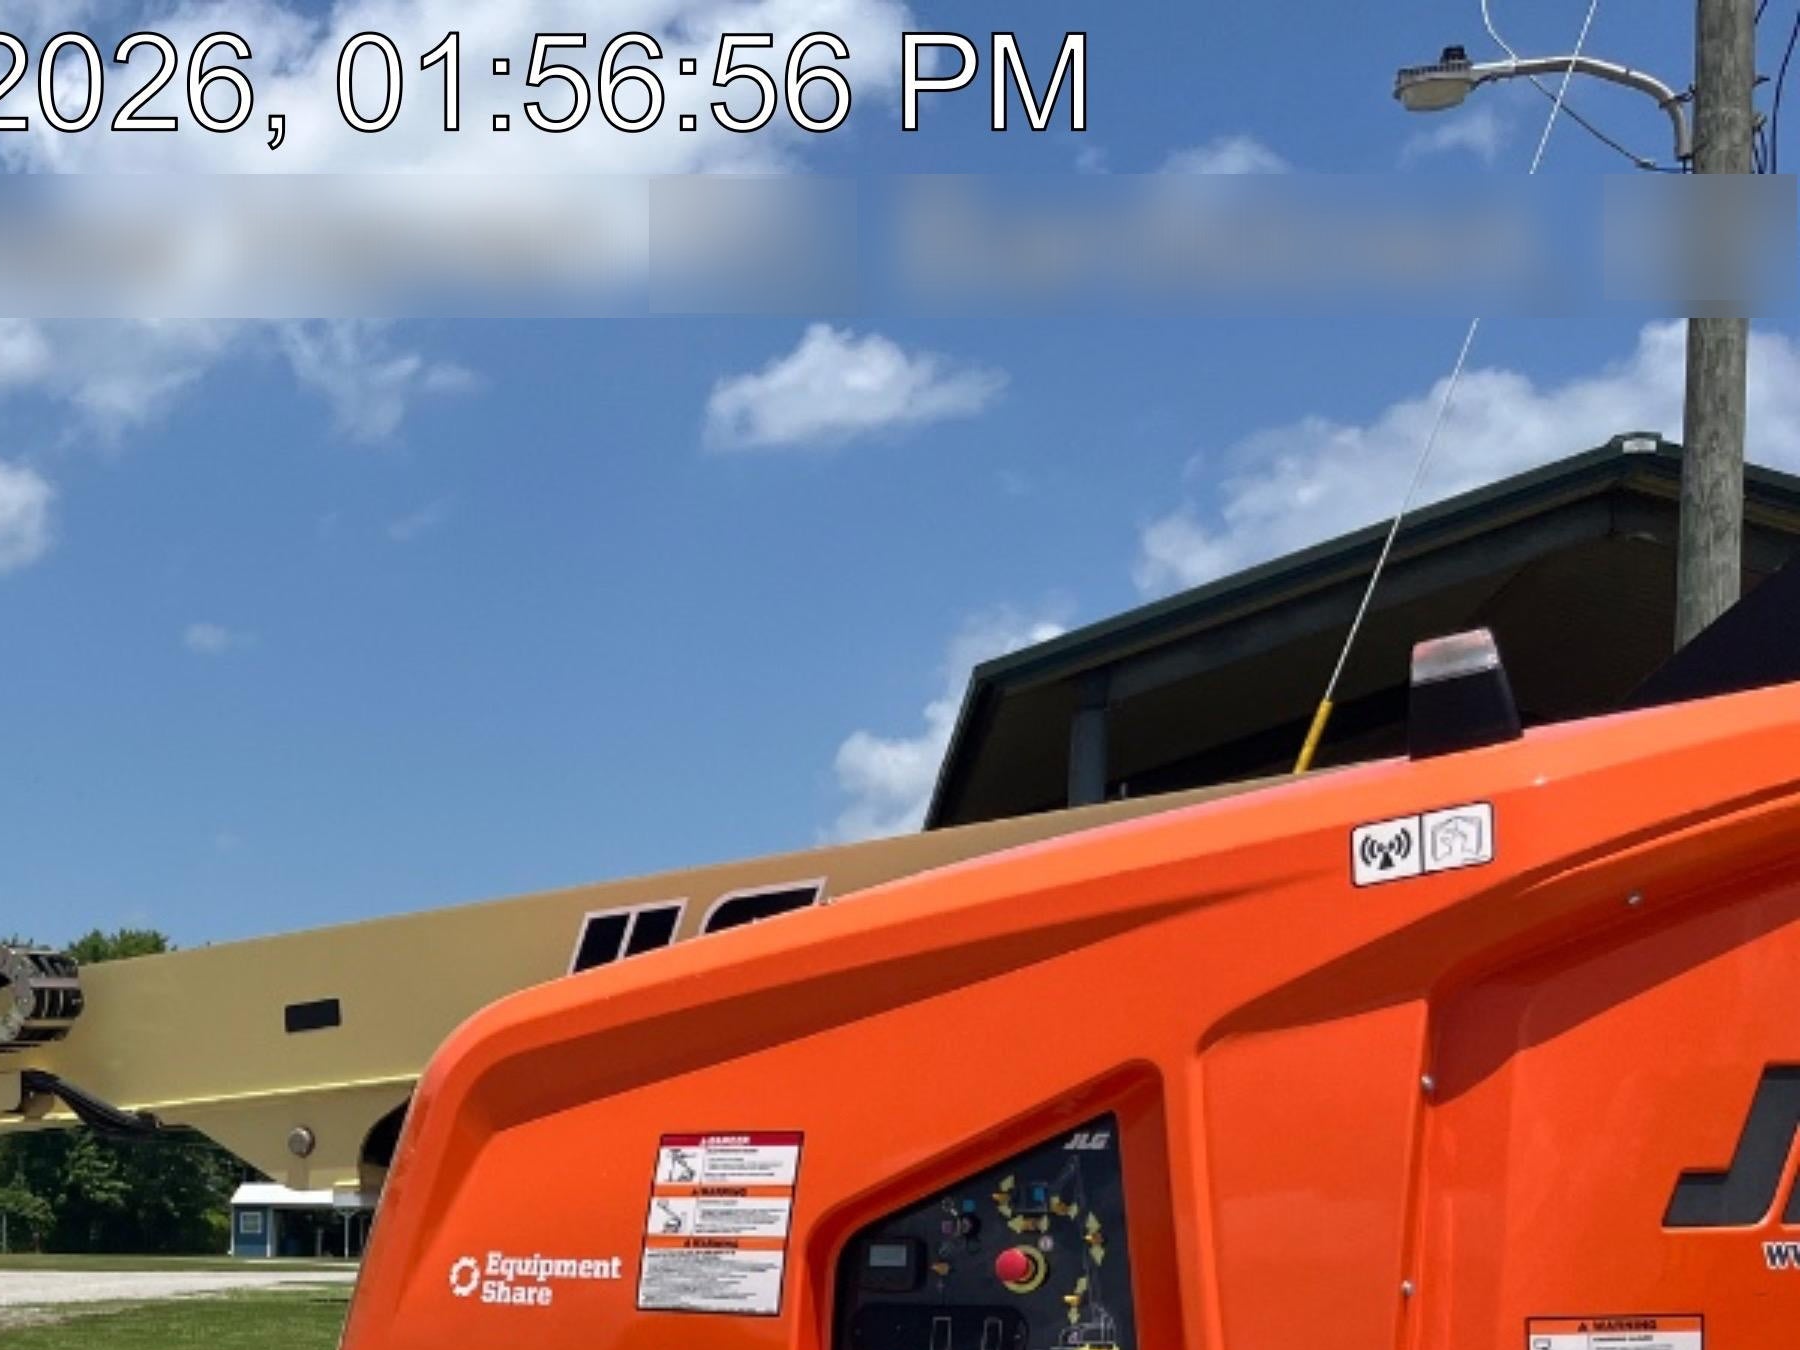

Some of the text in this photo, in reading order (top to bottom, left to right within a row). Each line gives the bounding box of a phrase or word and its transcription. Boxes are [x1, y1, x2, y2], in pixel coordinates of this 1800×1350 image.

[1063, 1131, 1110, 1151] JLG
[485, 1251, 622, 1282] Equipment
[481, 1280, 552, 1306] Share
